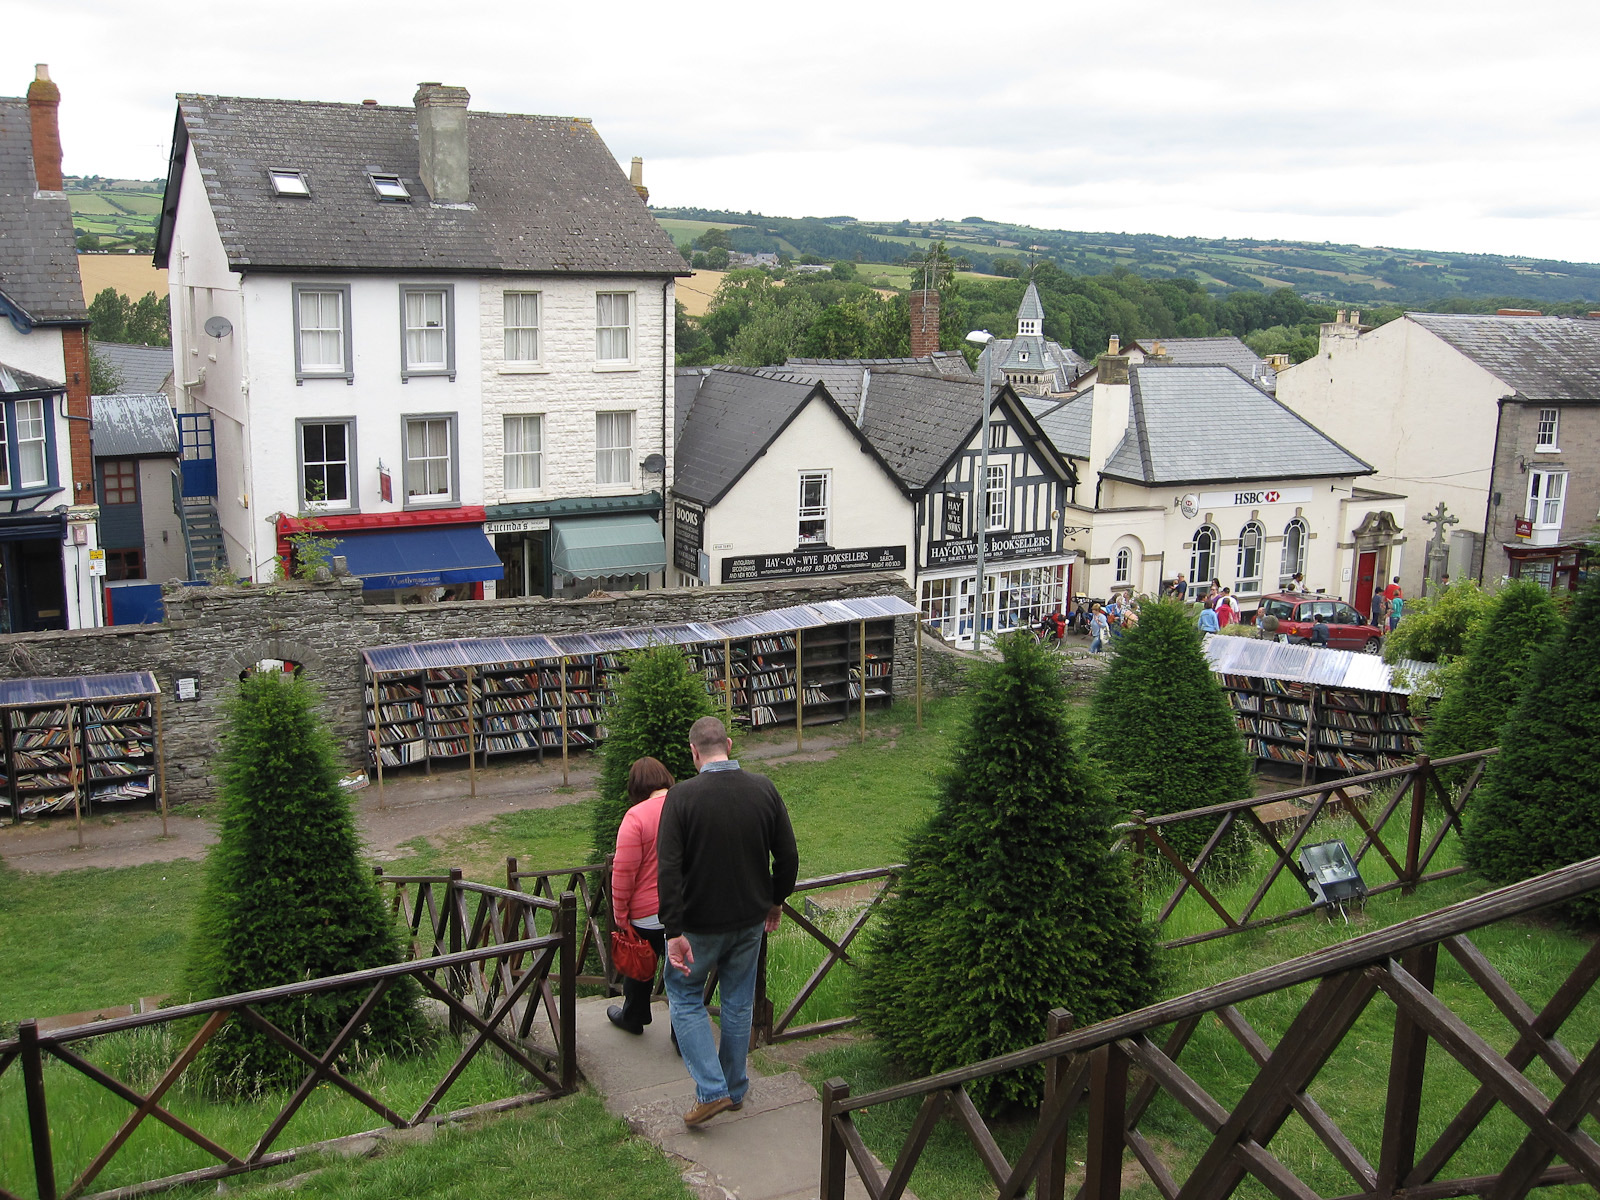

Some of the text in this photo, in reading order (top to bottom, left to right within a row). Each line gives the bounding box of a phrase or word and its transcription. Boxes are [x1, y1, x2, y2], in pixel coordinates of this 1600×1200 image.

[1234, 492, 1264, 505] HSBC
[947, 501, 961, 511] HAY
[676, 507, 698, 526] BOOKS
[947, 514, 961, 523] WYE
[486, 521, 528, 532] Lucinda's
[947, 522, 961, 533] BOOKS
[991, 536, 1051, 552] BOOKSELLERS
[765, 558, 780, 567] HAY
[785, 557, 797, 566] ON
[802, 555, 818, 565] WYE
[823, 551, 869, 564] BOOKSELLERS
[795, 565, 812, 573] 01497
[814, 564, 825, 572] 820
[827, 563, 838, 571] 875
